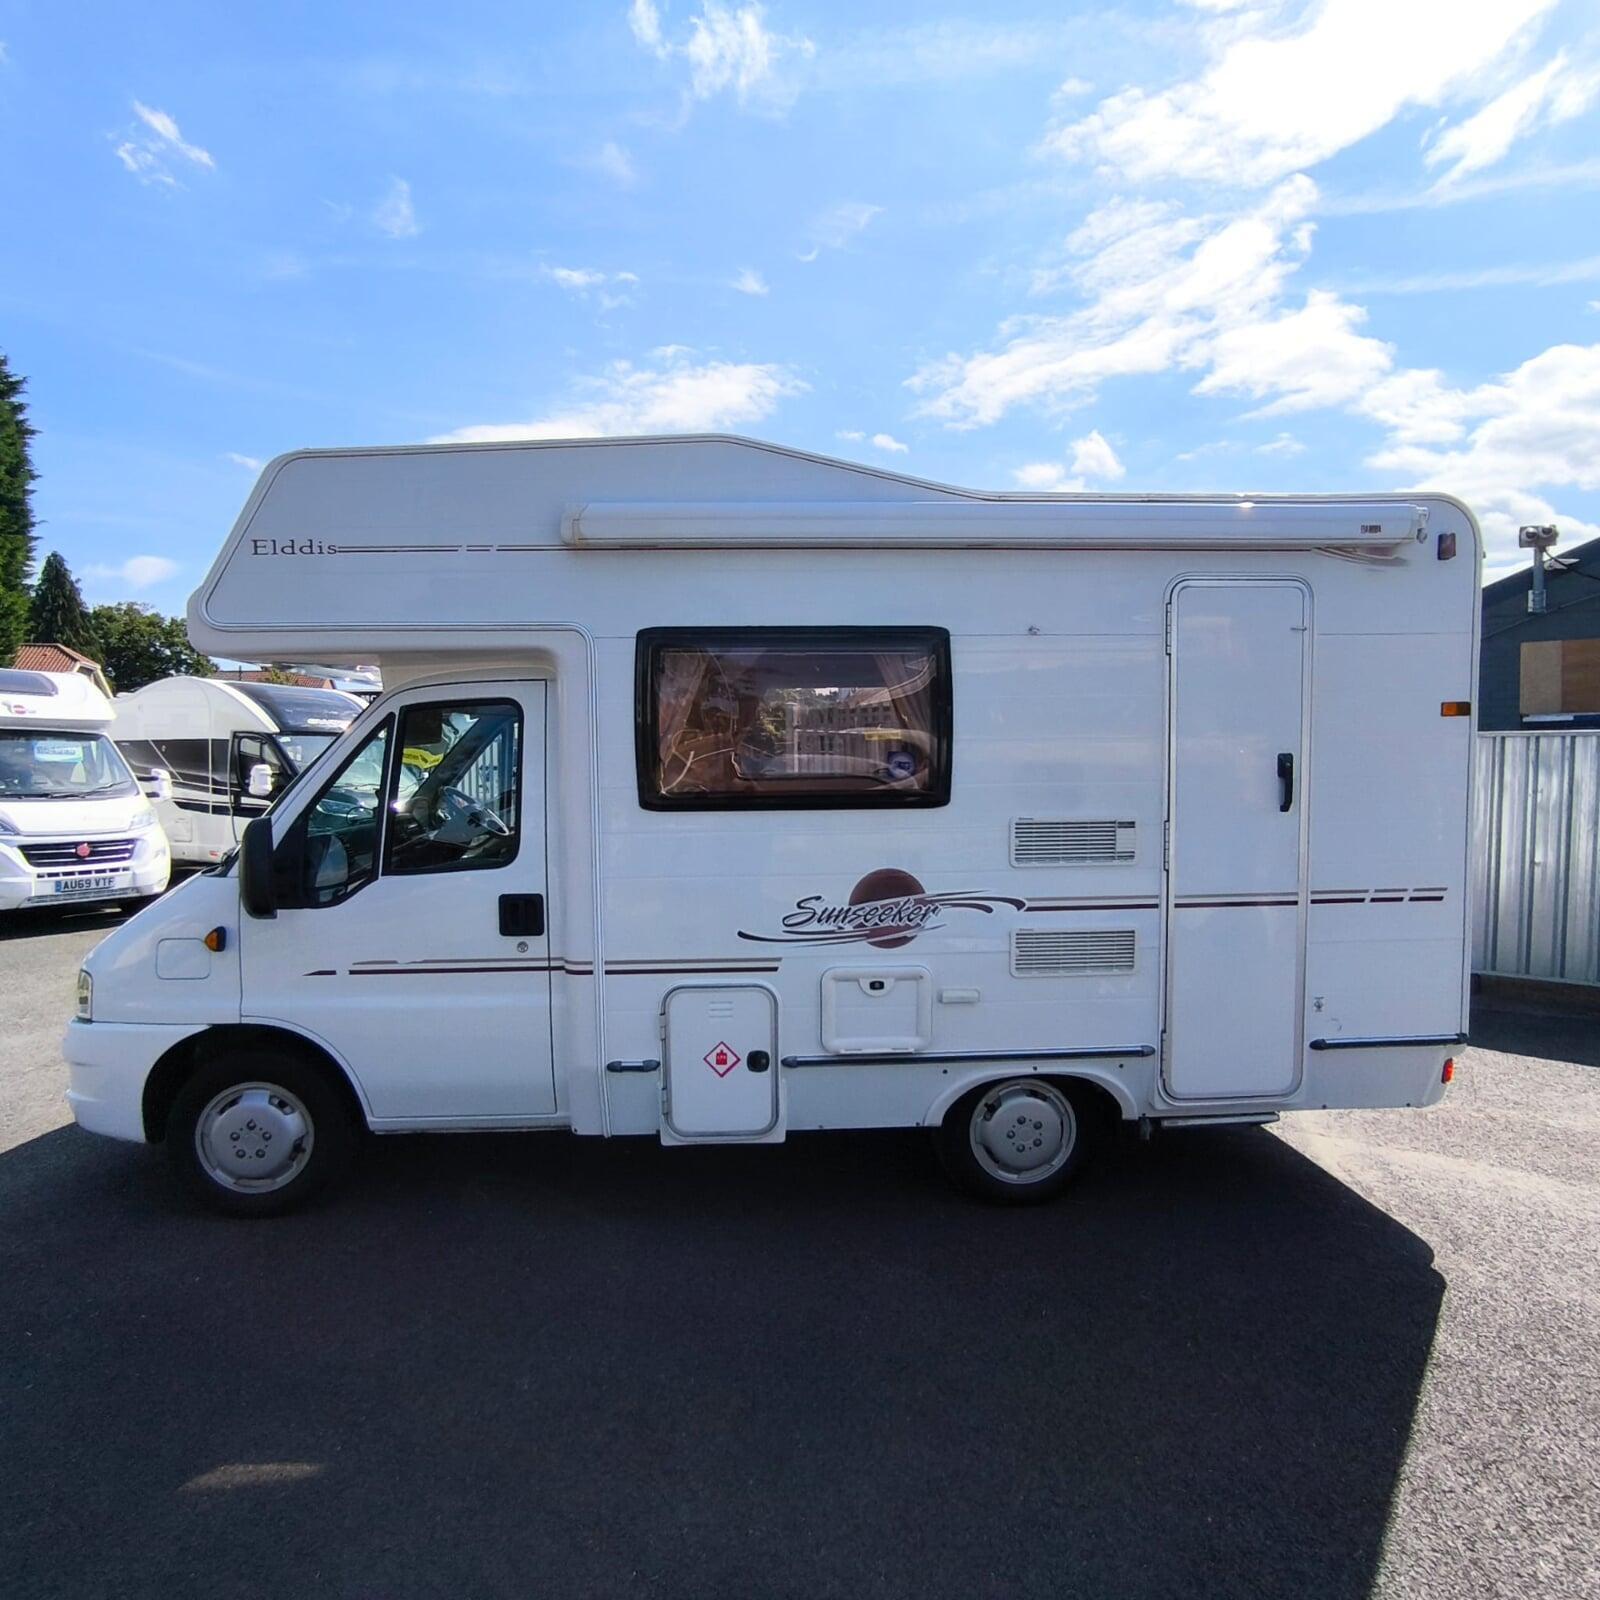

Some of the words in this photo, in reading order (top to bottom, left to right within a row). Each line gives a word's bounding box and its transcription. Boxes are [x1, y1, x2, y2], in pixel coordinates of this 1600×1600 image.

[251, 539, 337, 556] Elddis
[63, 879, 92, 890] AU69
[782, 895, 941, 928] Sunseeker
